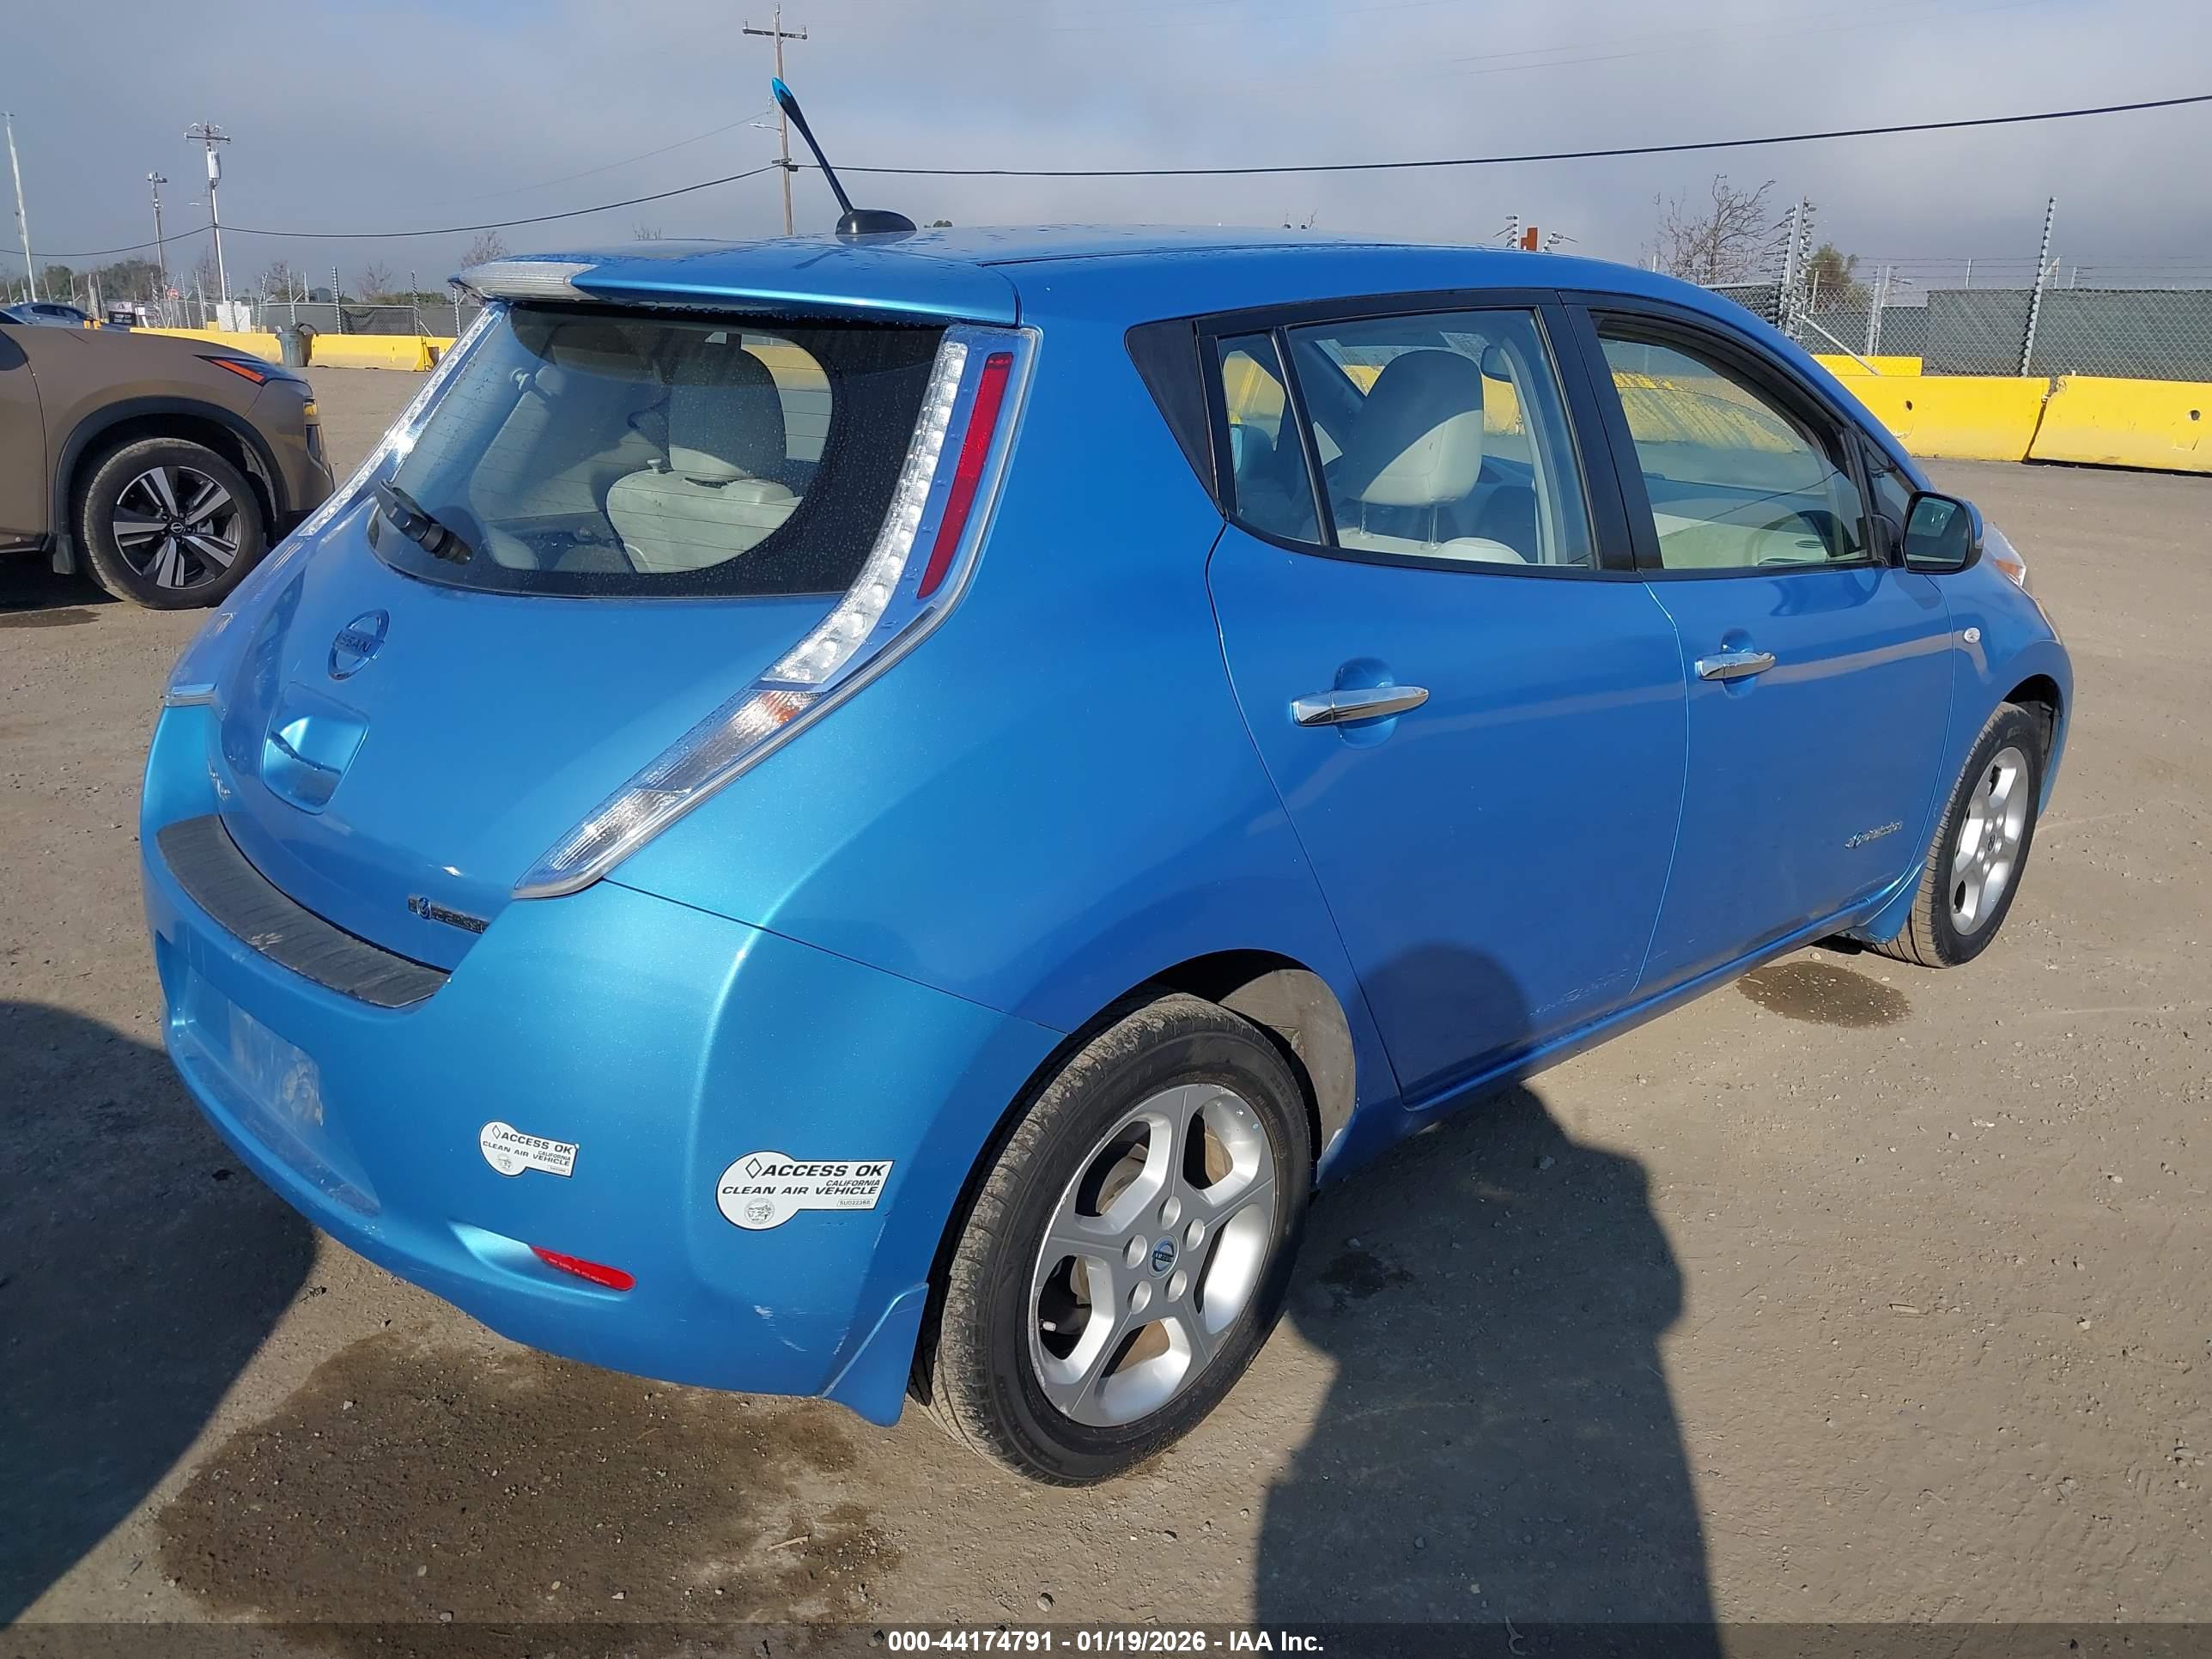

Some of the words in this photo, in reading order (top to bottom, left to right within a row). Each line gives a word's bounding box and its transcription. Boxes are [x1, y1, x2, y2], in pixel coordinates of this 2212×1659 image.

[501, 1132, 550, 1150] ACCESS
[554, 1144, 574, 1155] OK
[483, 1140, 511, 1152] CLEAN
[514, 1149, 529, 1158] AIR
[532, 1153, 570, 1167] VEHICLE
[538, 1150, 571, 1162] CALIFORNIA
[761, 1164, 848, 1176] ACCESS
[855, 1164, 888, 1176] OK
[722, 1186, 776, 1194] CLEAN
[781, 1186, 810, 1194] AIR
[815, 1186, 878, 1194] VEHICLE
